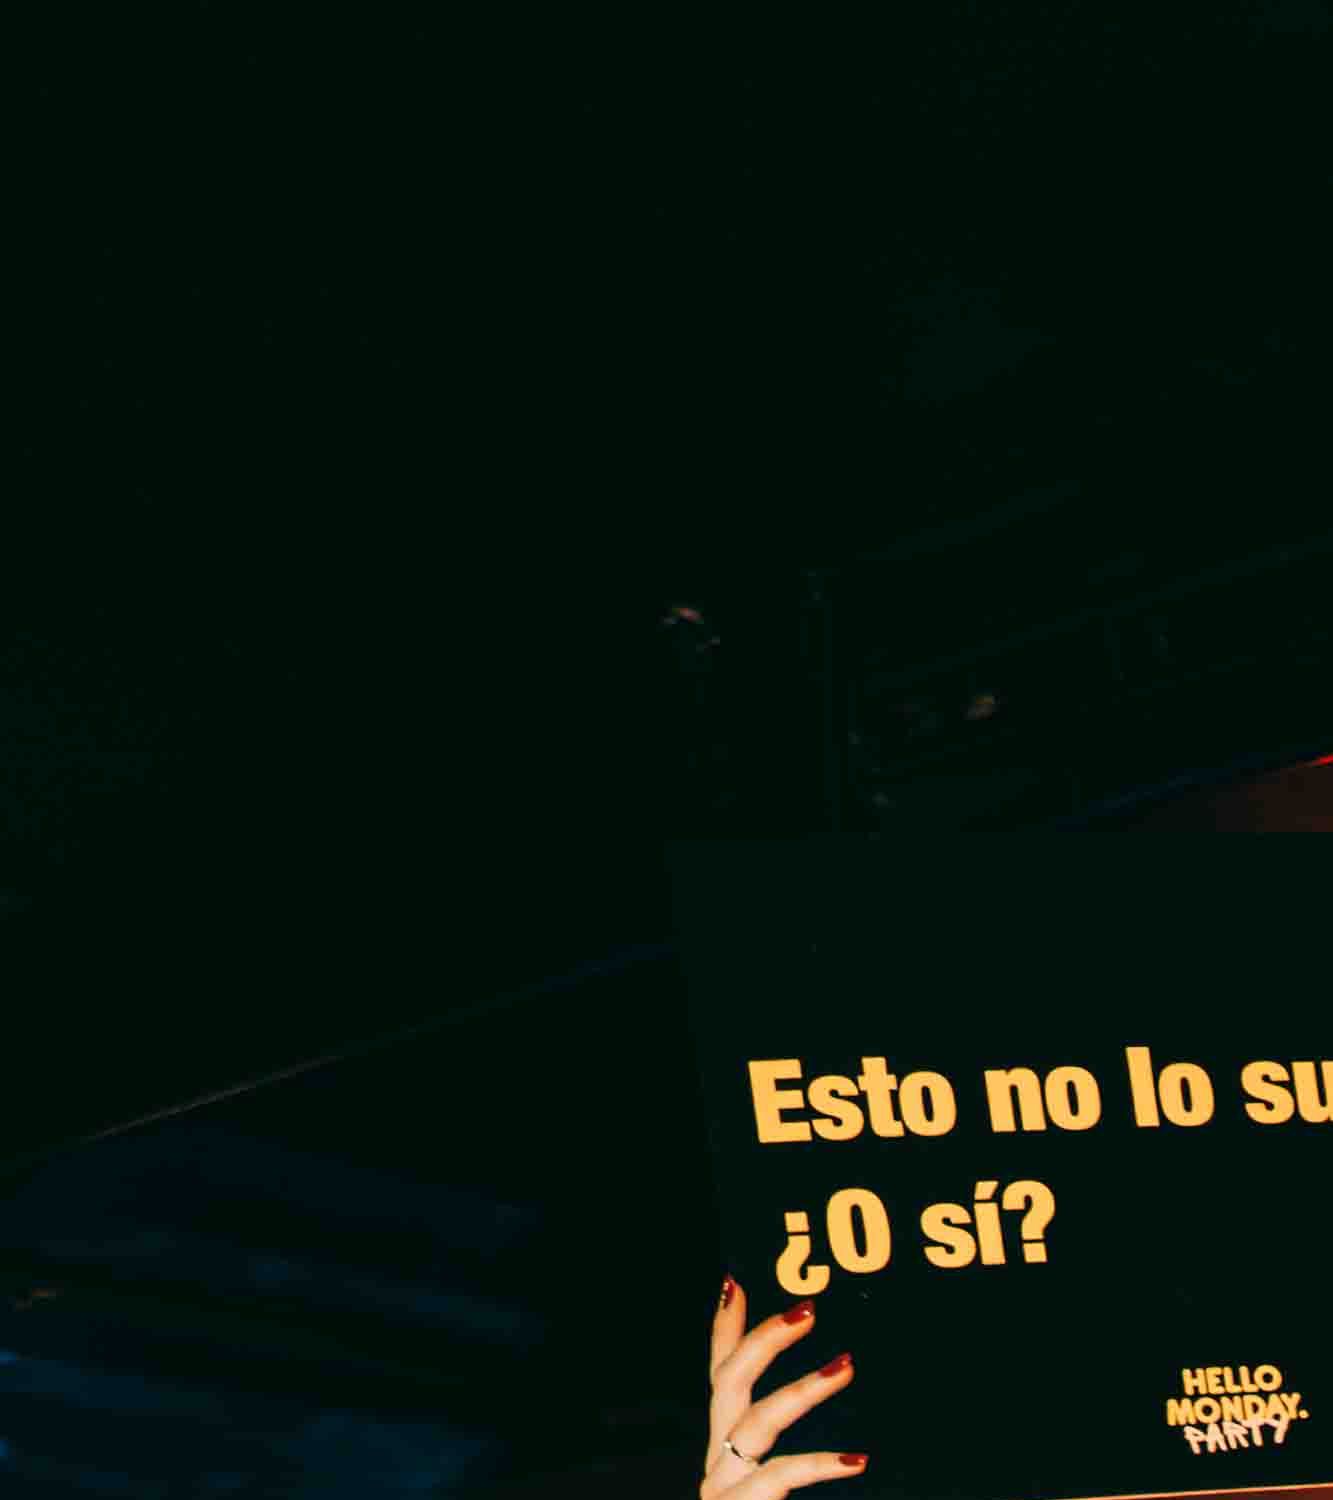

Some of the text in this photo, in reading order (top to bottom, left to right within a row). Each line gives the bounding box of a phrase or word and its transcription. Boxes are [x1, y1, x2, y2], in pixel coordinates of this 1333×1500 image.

[749, 1055, 957, 1143] Esto
[983, 1066, 1102, 1134] no
[1125, 1045, 1215, 1129] lo
[920, 1179, 1056, 1270] sí?
[1182, 1364, 1283, 1396] HELLO
[1166, 1392, 1310, 1426] MONDAY.
[1184, 1414, 1290, 1455] PARTY
